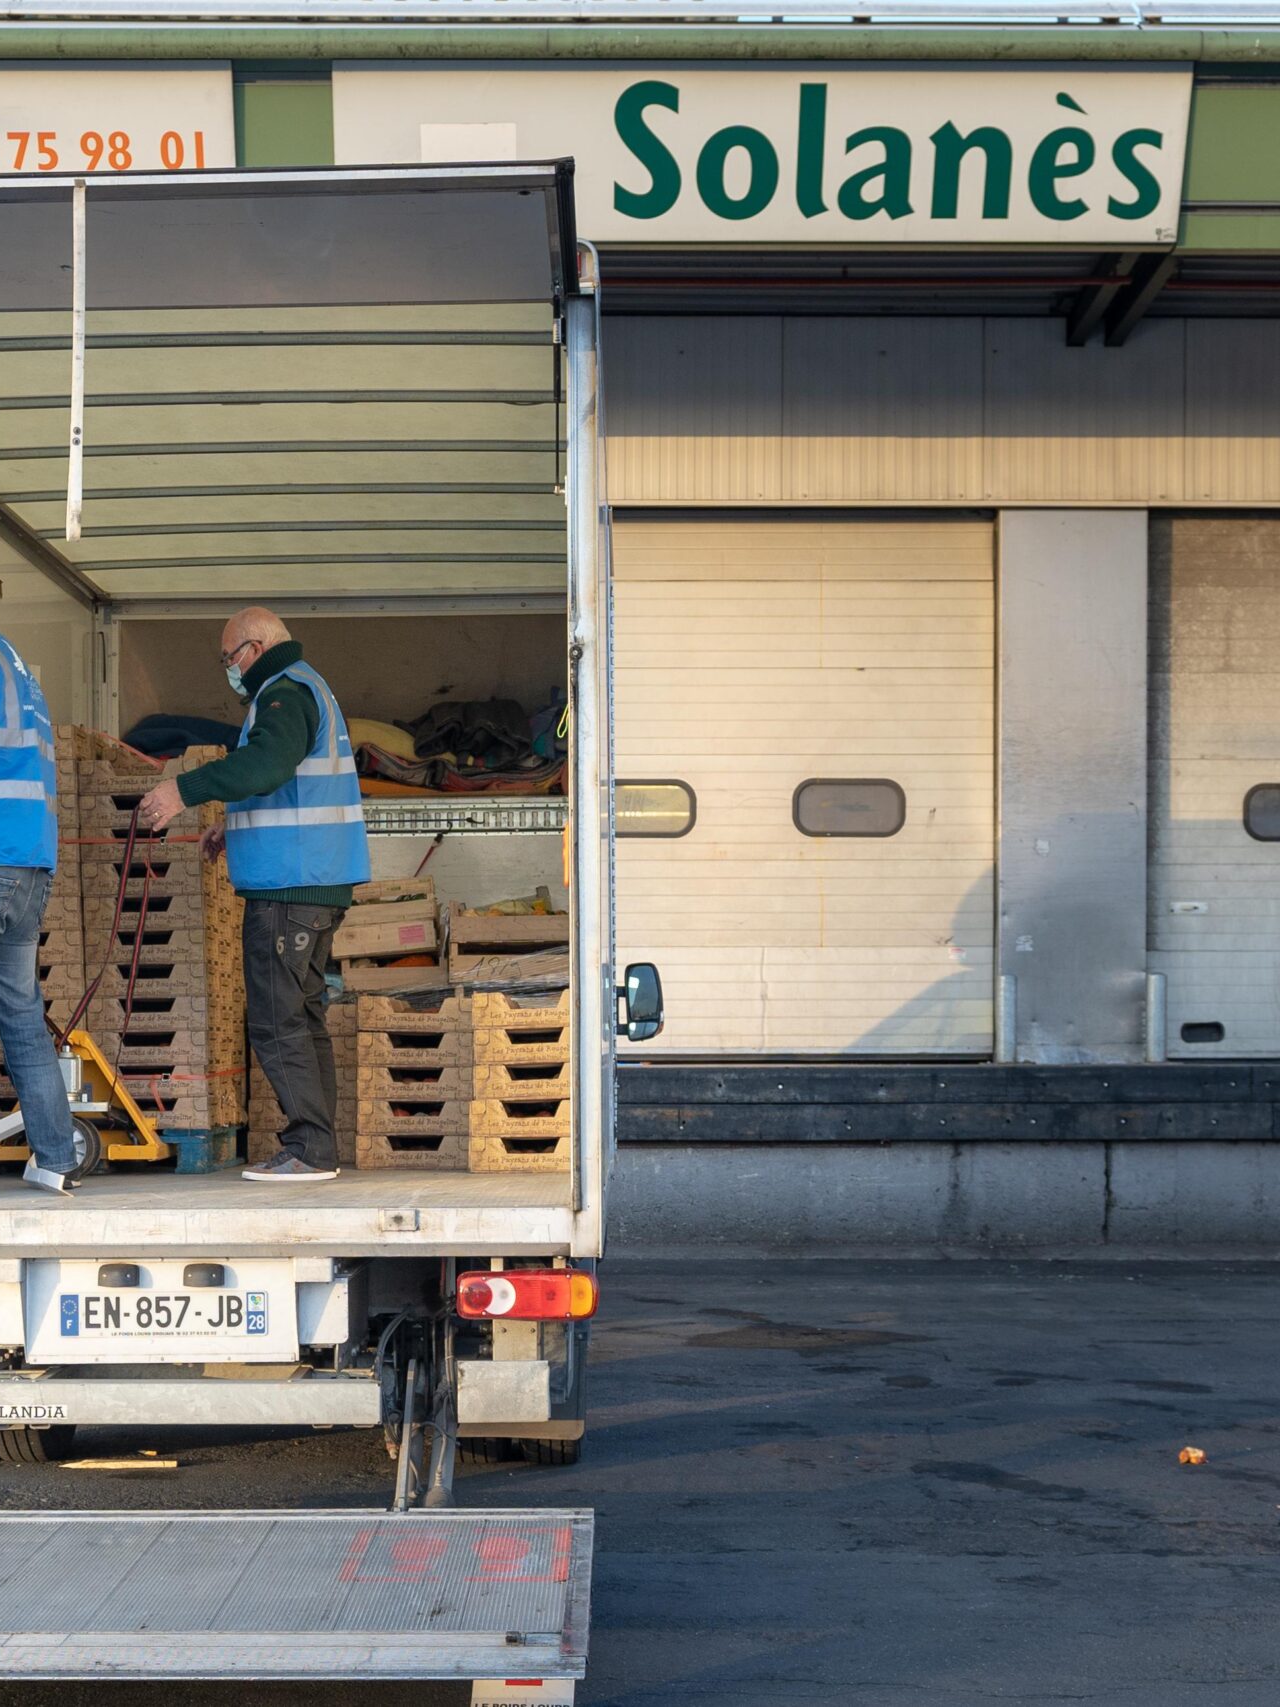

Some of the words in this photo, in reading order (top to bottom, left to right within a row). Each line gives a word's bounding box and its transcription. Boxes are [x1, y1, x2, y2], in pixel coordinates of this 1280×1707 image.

[6, 131, 59, 171] 75
[79, 130, 133, 171] 98
[159, 130, 205, 170] 01
[613, 81, 1162, 221] Solanès
[295, 932, 310, 951] 9
[66, 1319, 73, 1330] F
[85, 1295, 243, 1329] EN-857-JB
[248, 1314, 265, 1330] 28
